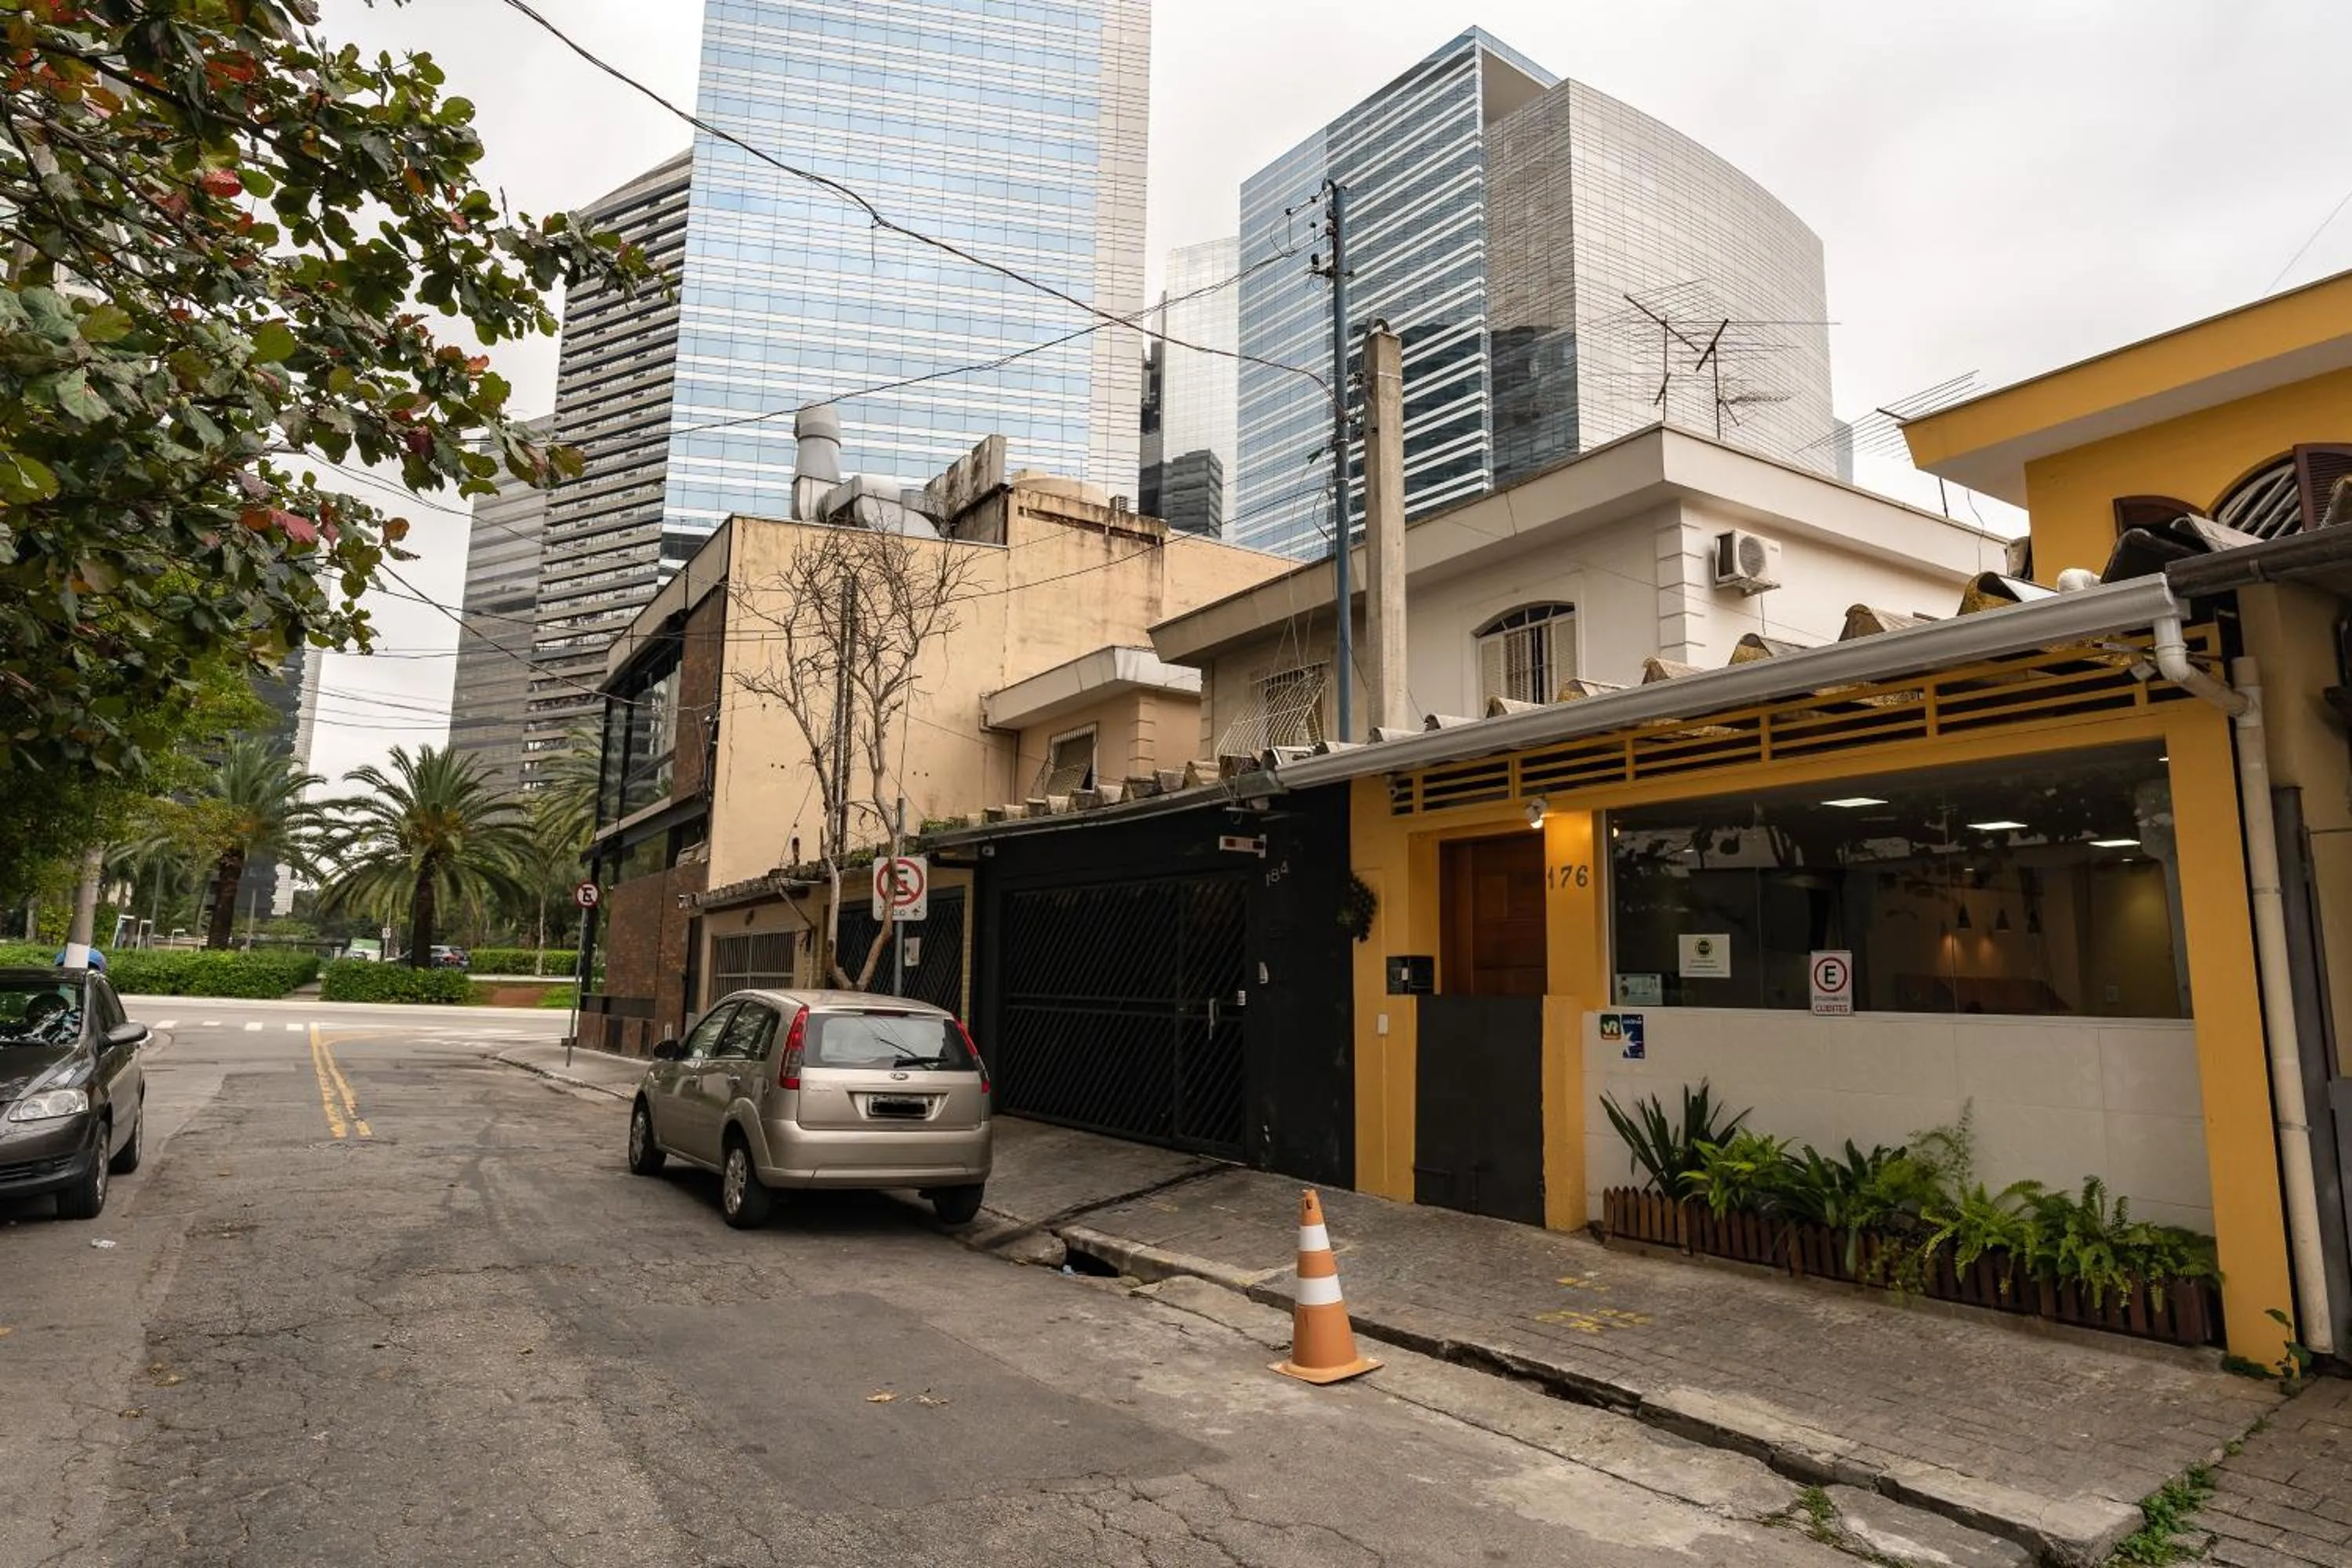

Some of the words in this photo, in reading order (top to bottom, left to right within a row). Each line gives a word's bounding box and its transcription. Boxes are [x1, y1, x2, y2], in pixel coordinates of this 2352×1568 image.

[1265, 861, 1289, 887] 184
[1548, 865, 1588, 890] 176
[1824, 965, 1837, 985] E
